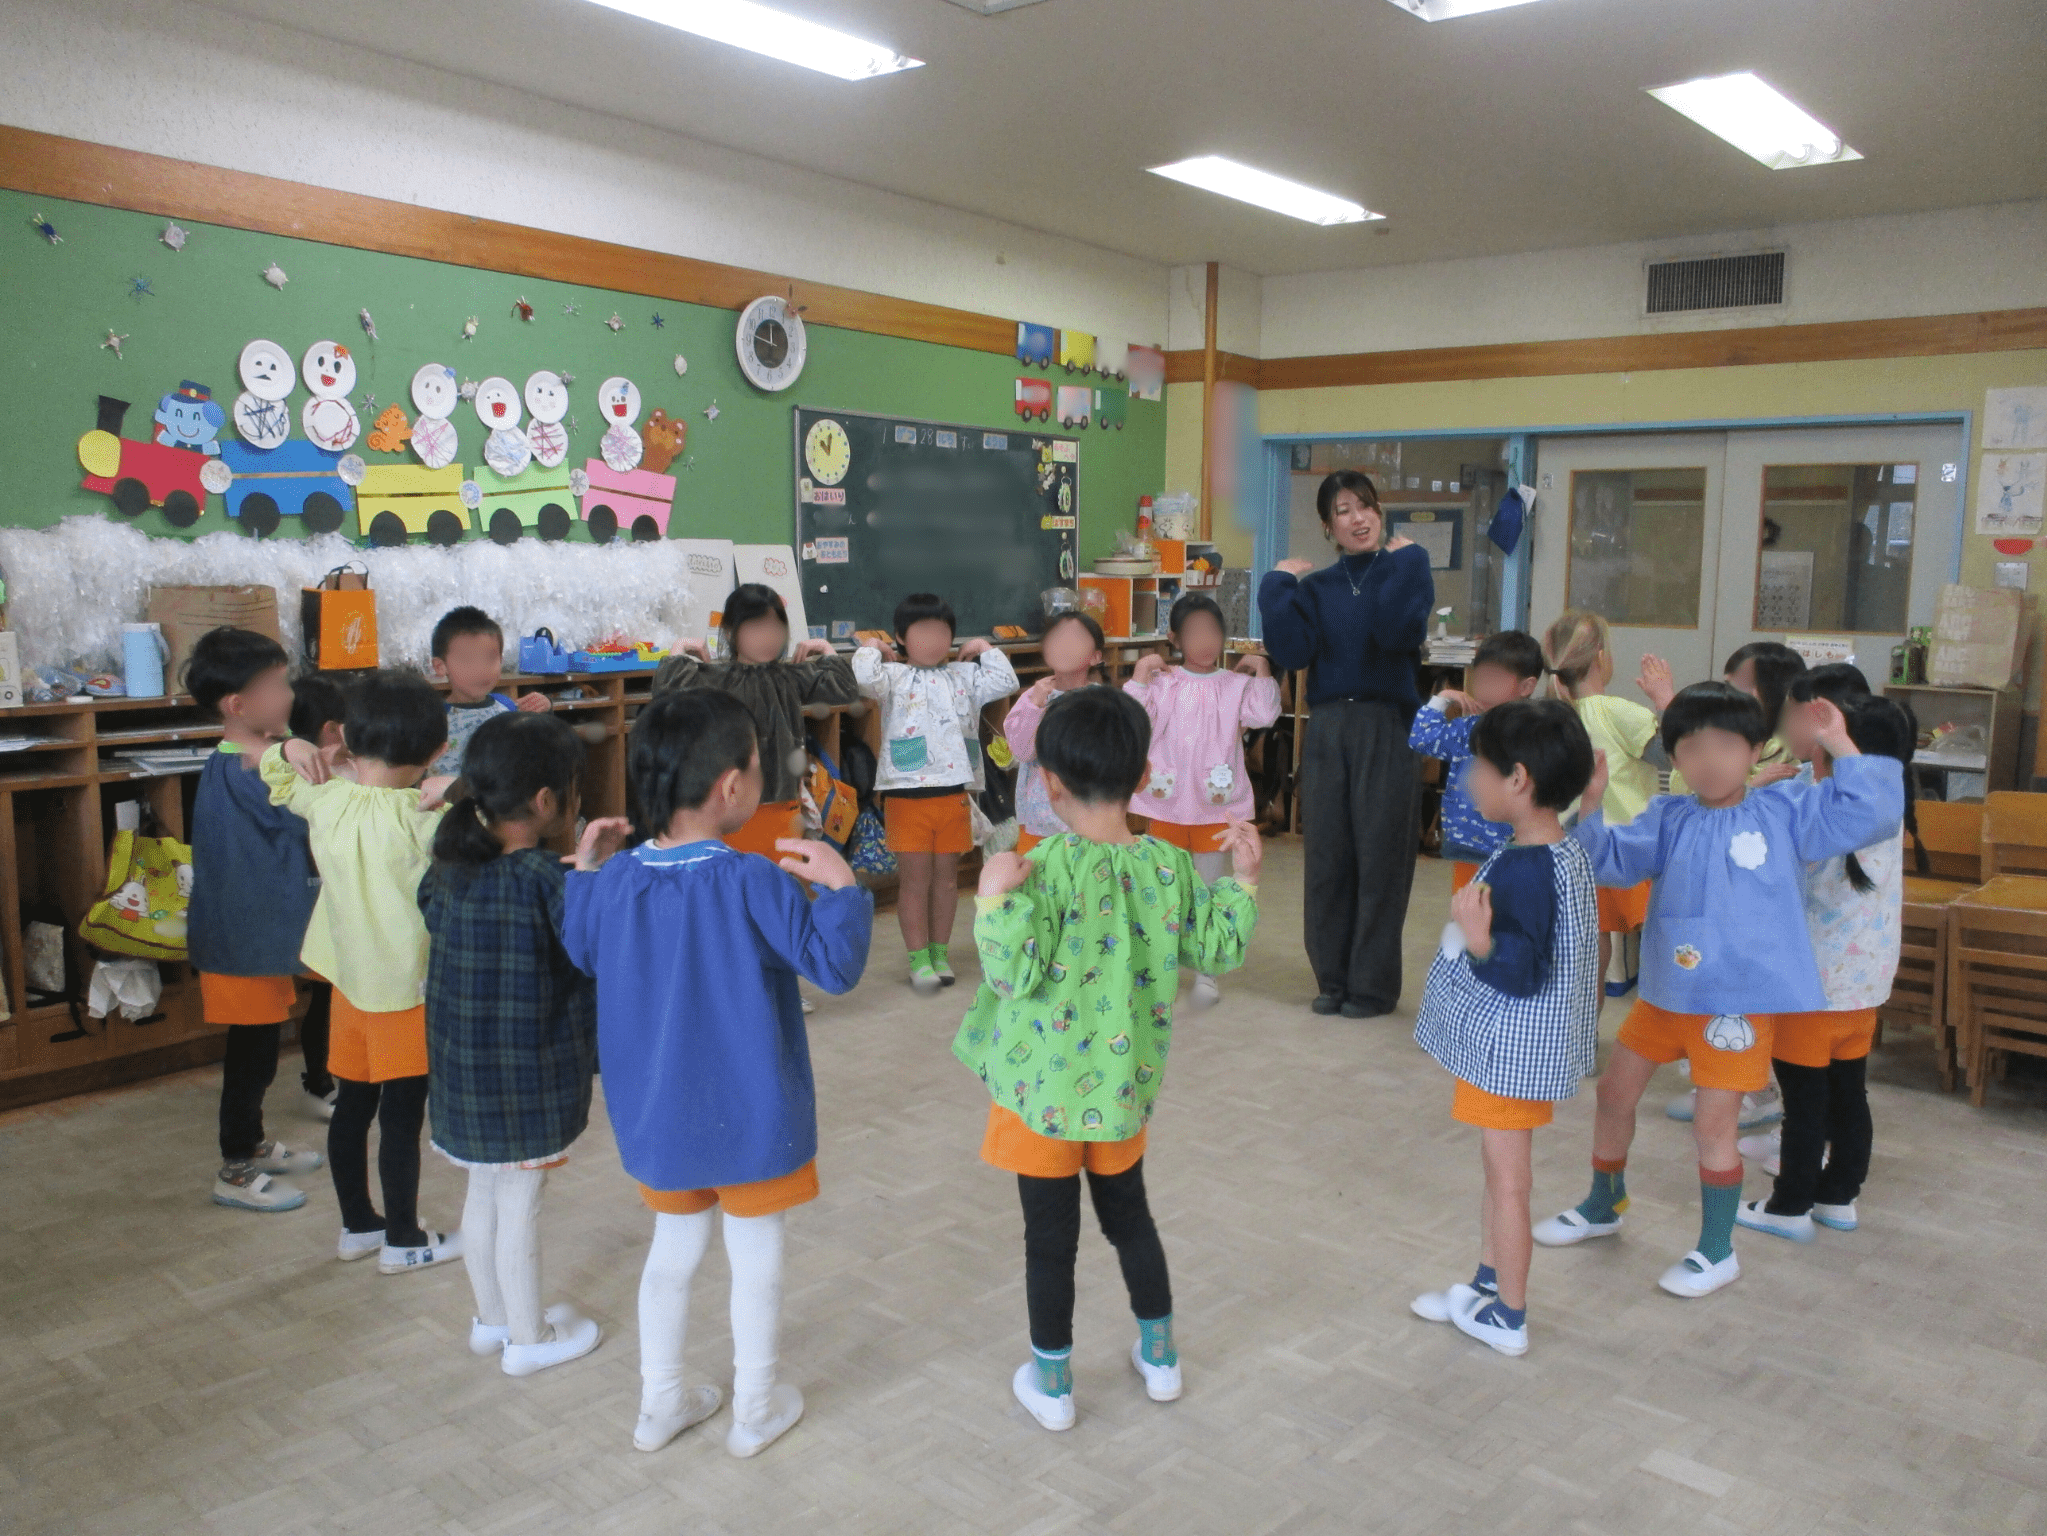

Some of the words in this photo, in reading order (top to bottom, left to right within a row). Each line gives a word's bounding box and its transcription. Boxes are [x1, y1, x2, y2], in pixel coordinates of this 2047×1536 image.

[920, 428, 934, 446] 28
[813, 490, 845, 502] おはいり
